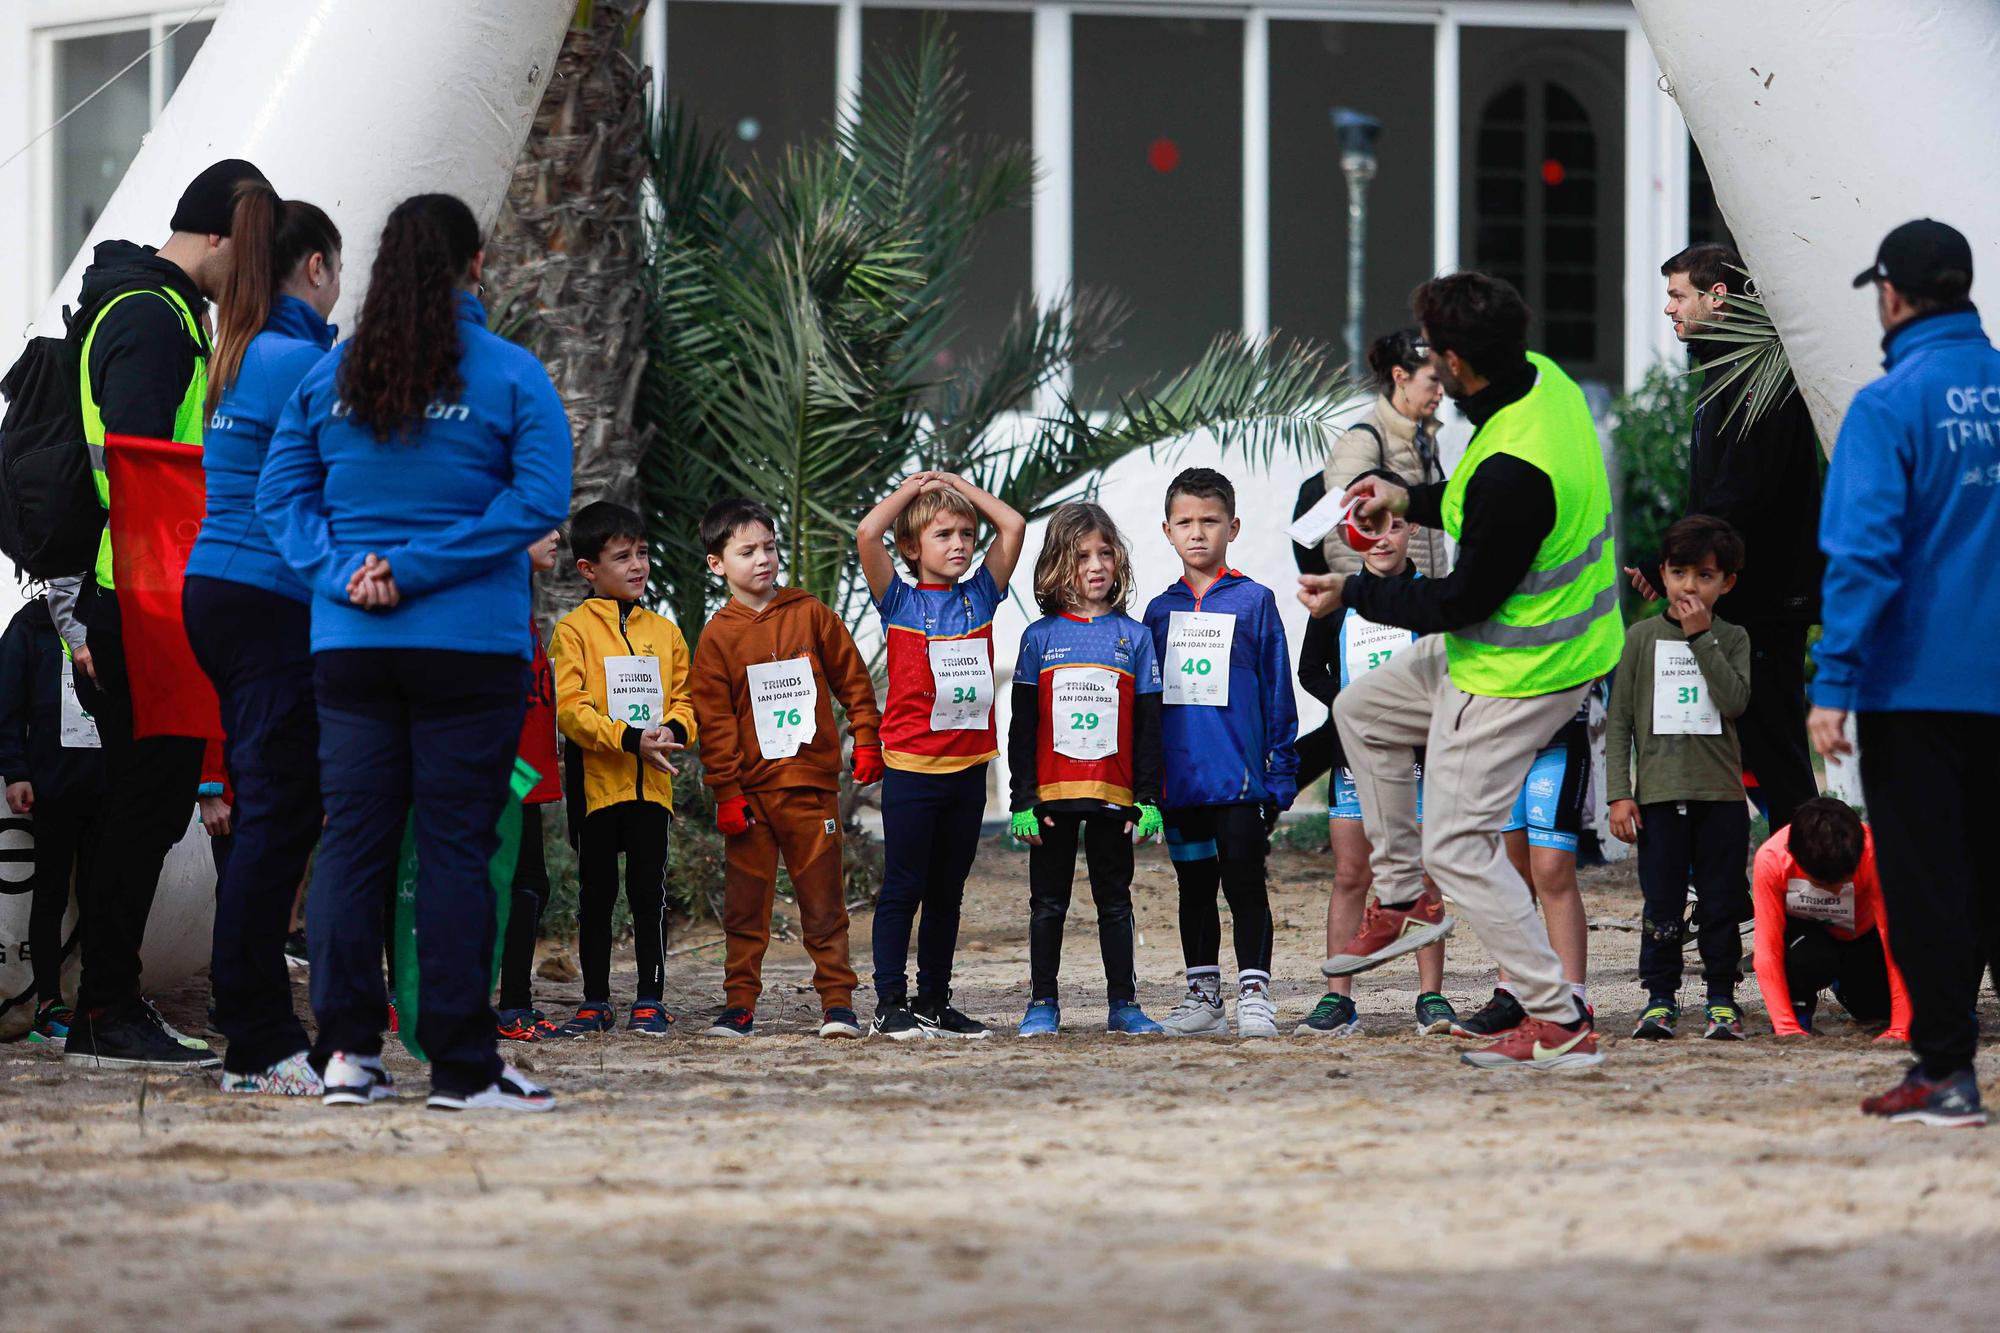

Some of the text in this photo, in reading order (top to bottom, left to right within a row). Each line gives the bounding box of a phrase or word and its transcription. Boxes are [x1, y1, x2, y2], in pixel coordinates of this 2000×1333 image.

[1946, 386, 2000, 415] OFC
[1183, 628, 1221, 638] TRIKIDS
[1353, 640, 1366, 648] SAN
[1368, 635, 1387, 645] JOAN
[941, 657, 979, 667] TRIKIDS
[1181, 658, 1211, 675] 40
[1368, 650, 1393, 670] 37
[618, 674, 652, 682] TRIKIDS
[762, 677, 802, 690] TRIKIDS
[952, 687, 977, 704] 34
[1065, 682, 1105, 692] TRIKIDS
[1678, 687, 1699, 704] 31
[757, 694, 772, 702] SAN
[774, 691, 793, 700] JOAN
[628, 704, 651, 721] 28
[773, 708, 802, 728] 76
[1070, 712, 1099, 730] 29
